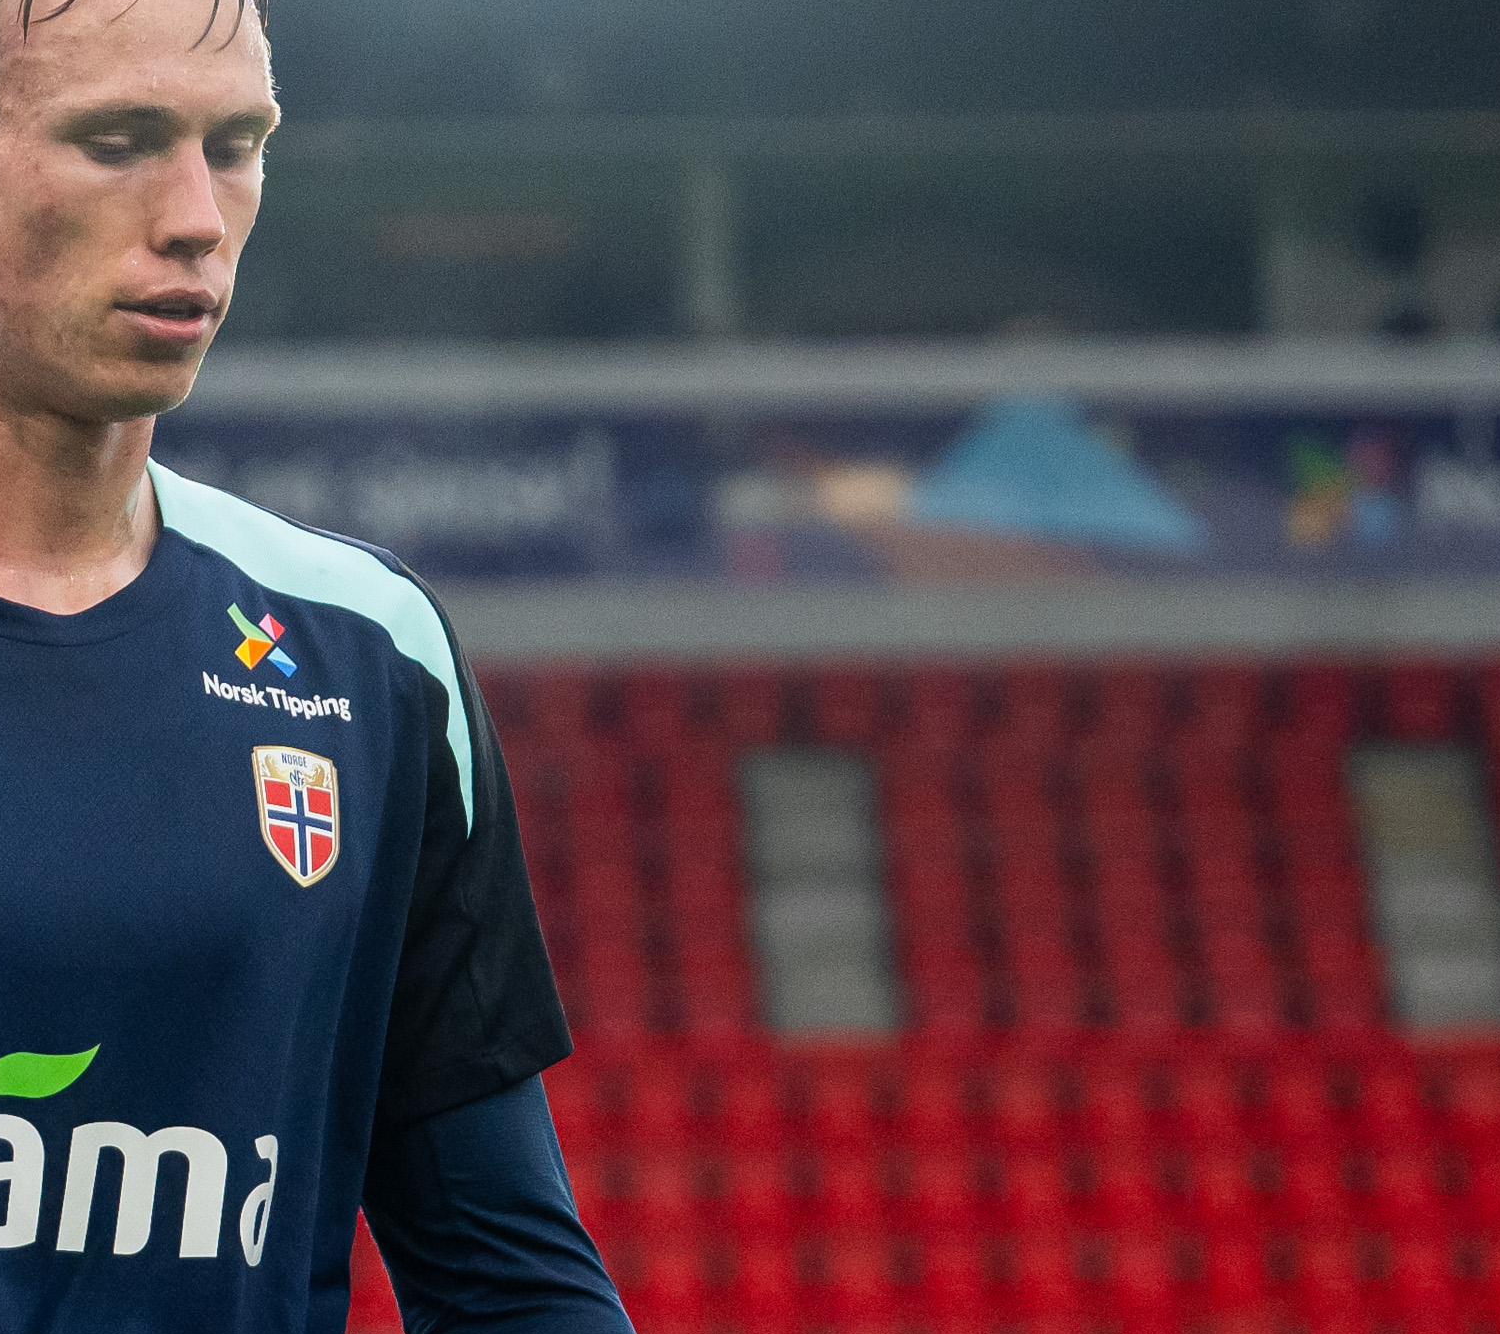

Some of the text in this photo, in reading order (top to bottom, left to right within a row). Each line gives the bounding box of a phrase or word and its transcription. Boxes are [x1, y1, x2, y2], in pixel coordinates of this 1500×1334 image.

[202, 671, 352, 722] Norsk Tipping
[280, 752, 308, 768] NORGE
